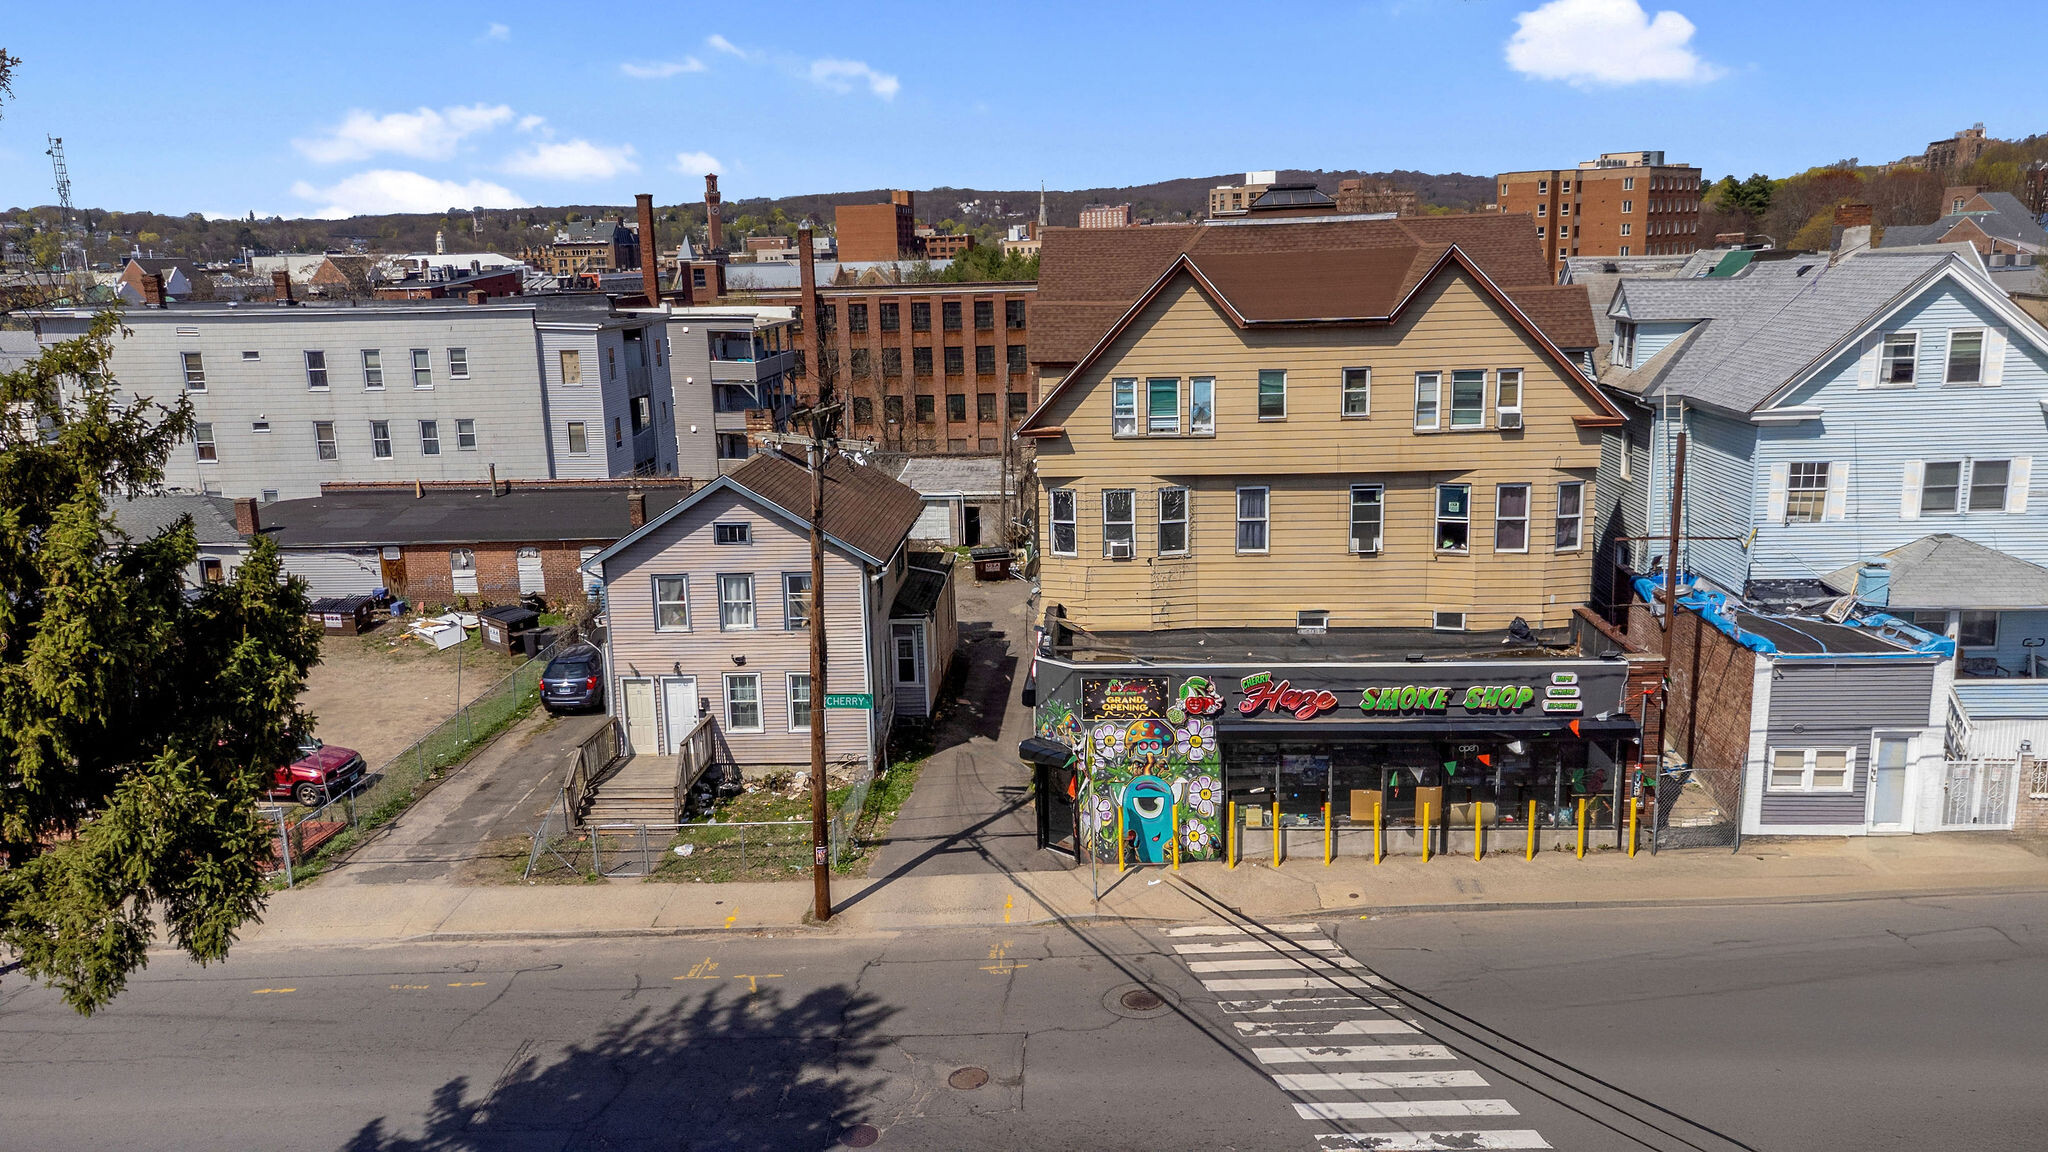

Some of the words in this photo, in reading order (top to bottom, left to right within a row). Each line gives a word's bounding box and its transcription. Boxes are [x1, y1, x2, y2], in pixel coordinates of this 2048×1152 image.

[1242, 674, 1270, 689] CHERRY
[826, 696, 865, 706] CHERRY
[1106, 696, 1145, 704] GRAND
[1239, 680, 1337, 720] Haze
[1359, 685, 1452, 710] SMOKE
[1462, 685, 1534, 710] SHOP
[1101, 703, 1149, 711] OPENING
[1458, 744, 1480, 756] open
